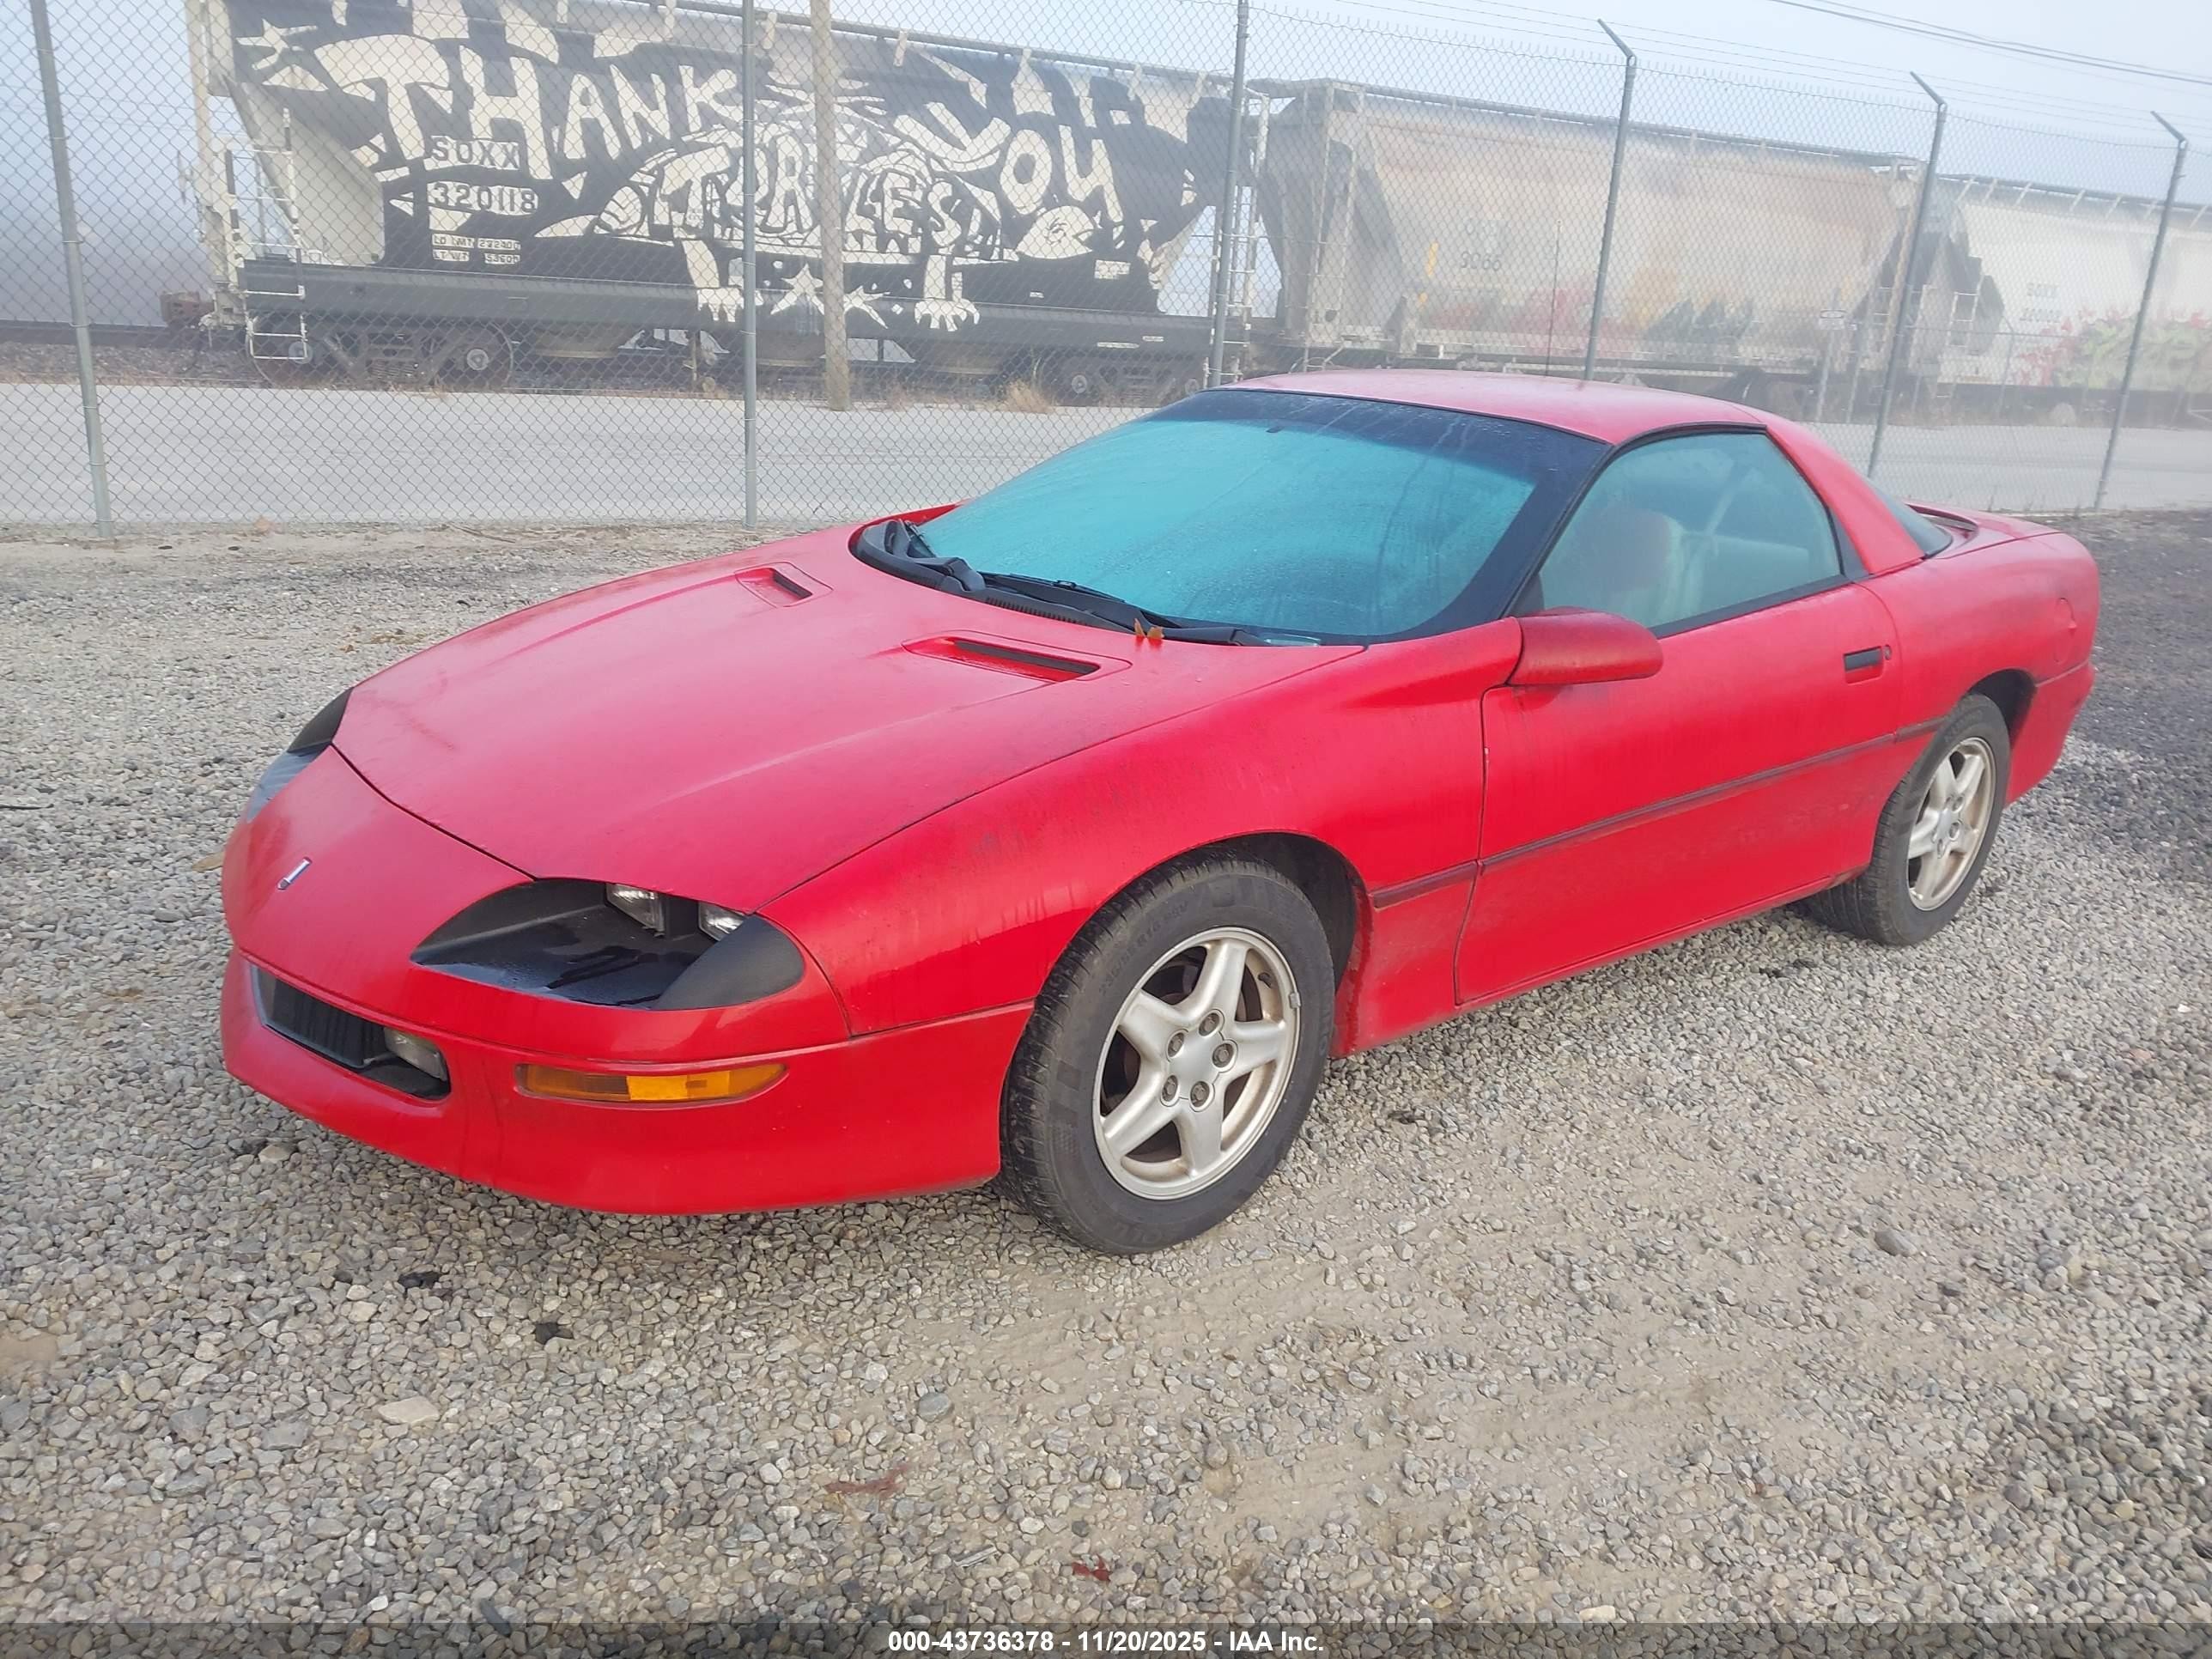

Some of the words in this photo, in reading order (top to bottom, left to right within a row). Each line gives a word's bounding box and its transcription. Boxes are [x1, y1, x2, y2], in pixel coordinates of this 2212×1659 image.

[314, 34, 740, 180] THANK
[894, 102, 1124, 222] YOU
[429, 137, 520, 168] SOXX
[432, 182, 536, 213] 320118
[659, 135, 962, 246] TURLES
